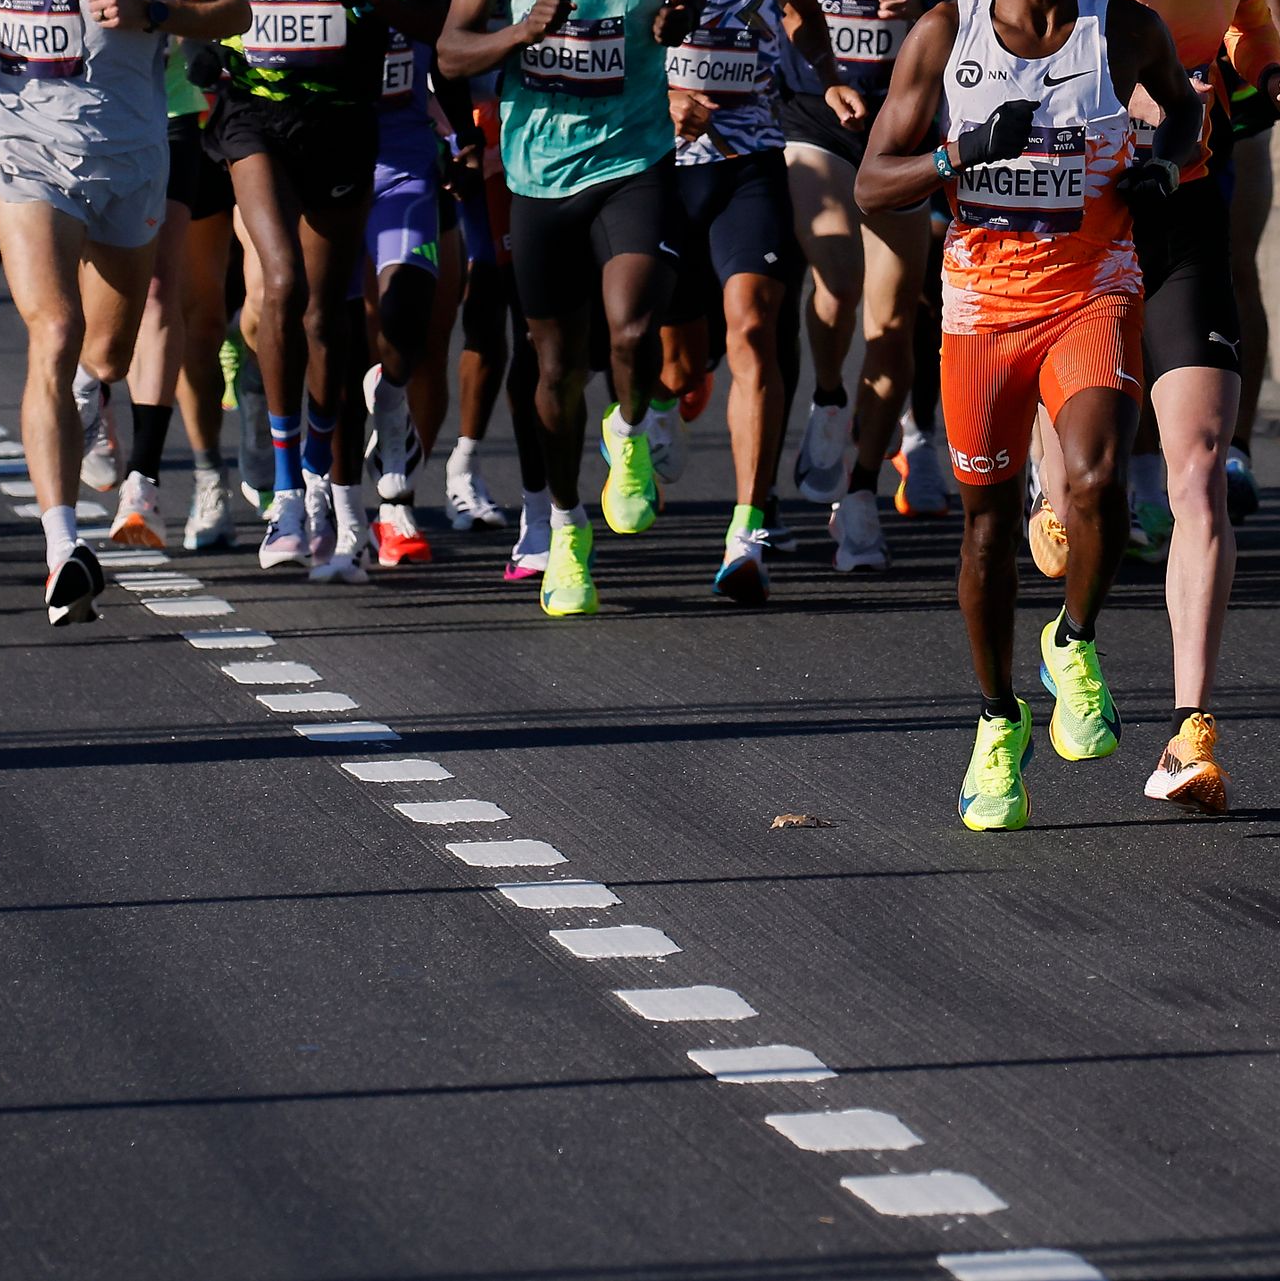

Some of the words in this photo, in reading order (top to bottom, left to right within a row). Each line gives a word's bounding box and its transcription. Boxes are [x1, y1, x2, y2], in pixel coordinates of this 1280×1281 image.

[51, 4, 70, 12] TATA
[255, 14, 333, 43] KIBET
[523, 46, 623, 73] GOBENA
[666, 56, 755, 83] AT-OCHIR
[987, 70, 1008, 81] NN
[1053, 143, 1075, 151] TATA
[959, 166, 1083, 197] NAGEEYE
